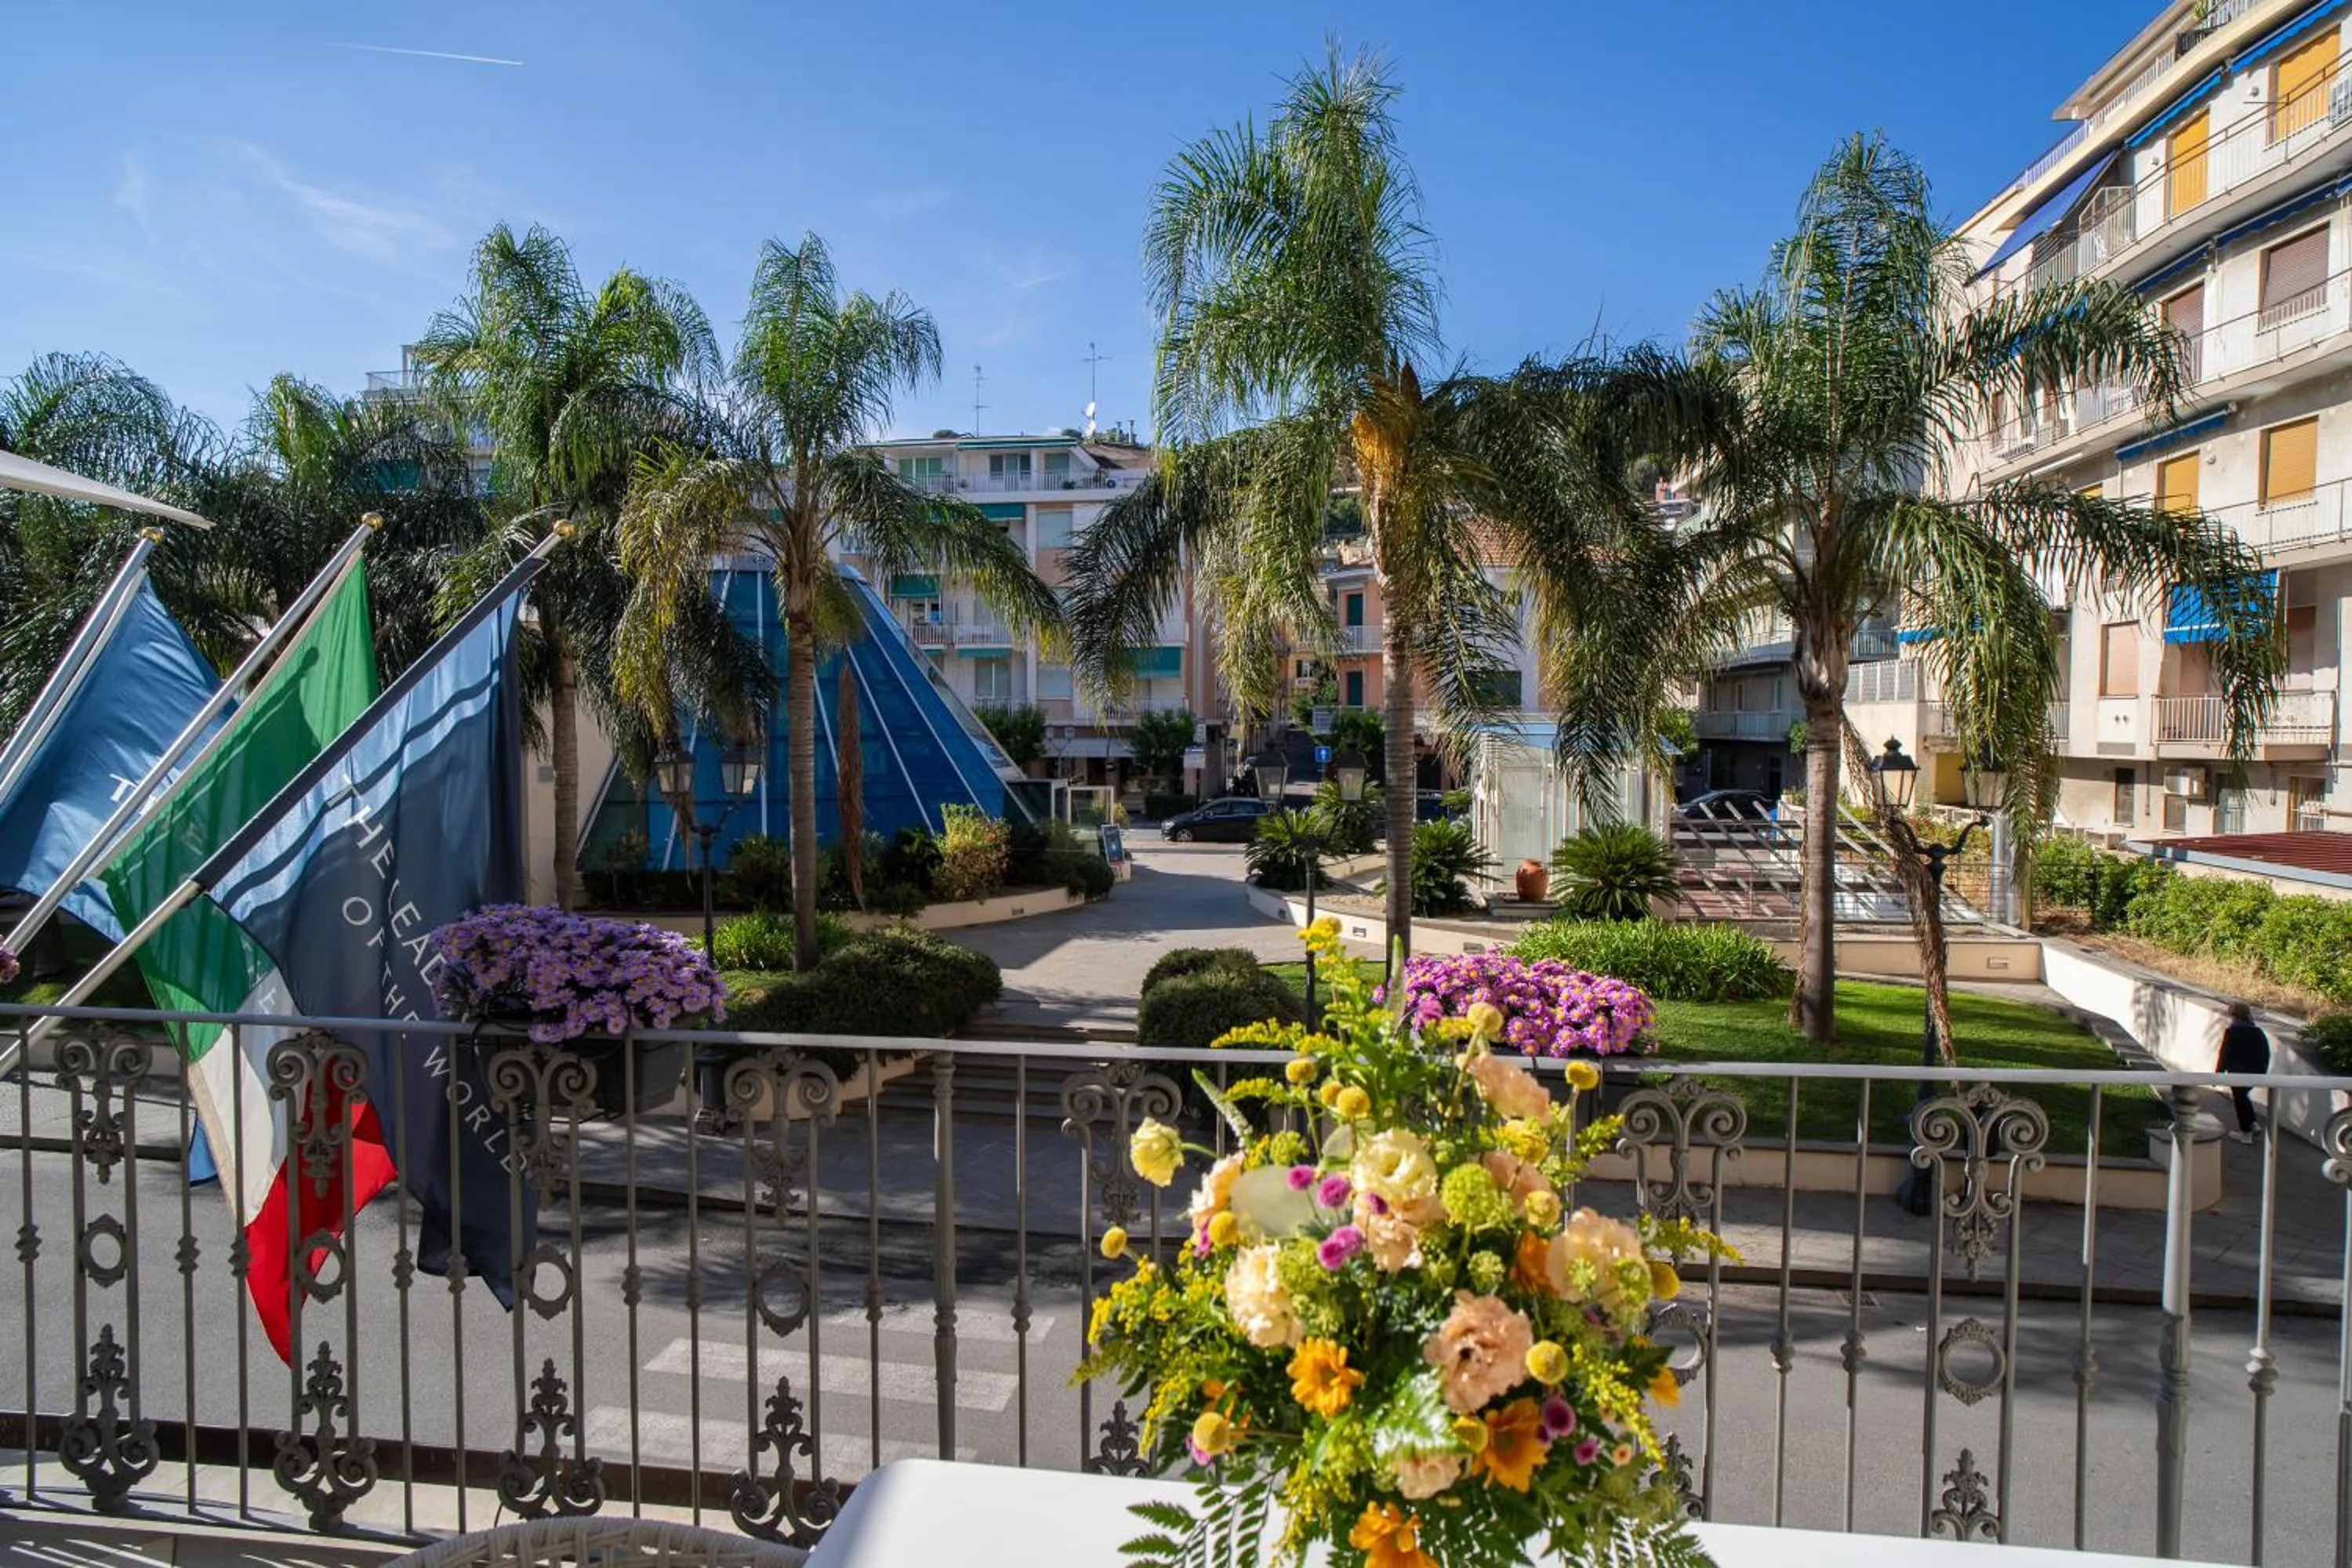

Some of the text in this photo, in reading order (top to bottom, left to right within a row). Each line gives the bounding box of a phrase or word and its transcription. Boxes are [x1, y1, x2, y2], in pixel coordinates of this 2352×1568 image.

[328, 774, 394, 880] THE
[342, 896, 386, 947] OF
[423, 1045, 528, 1174] WORLD
